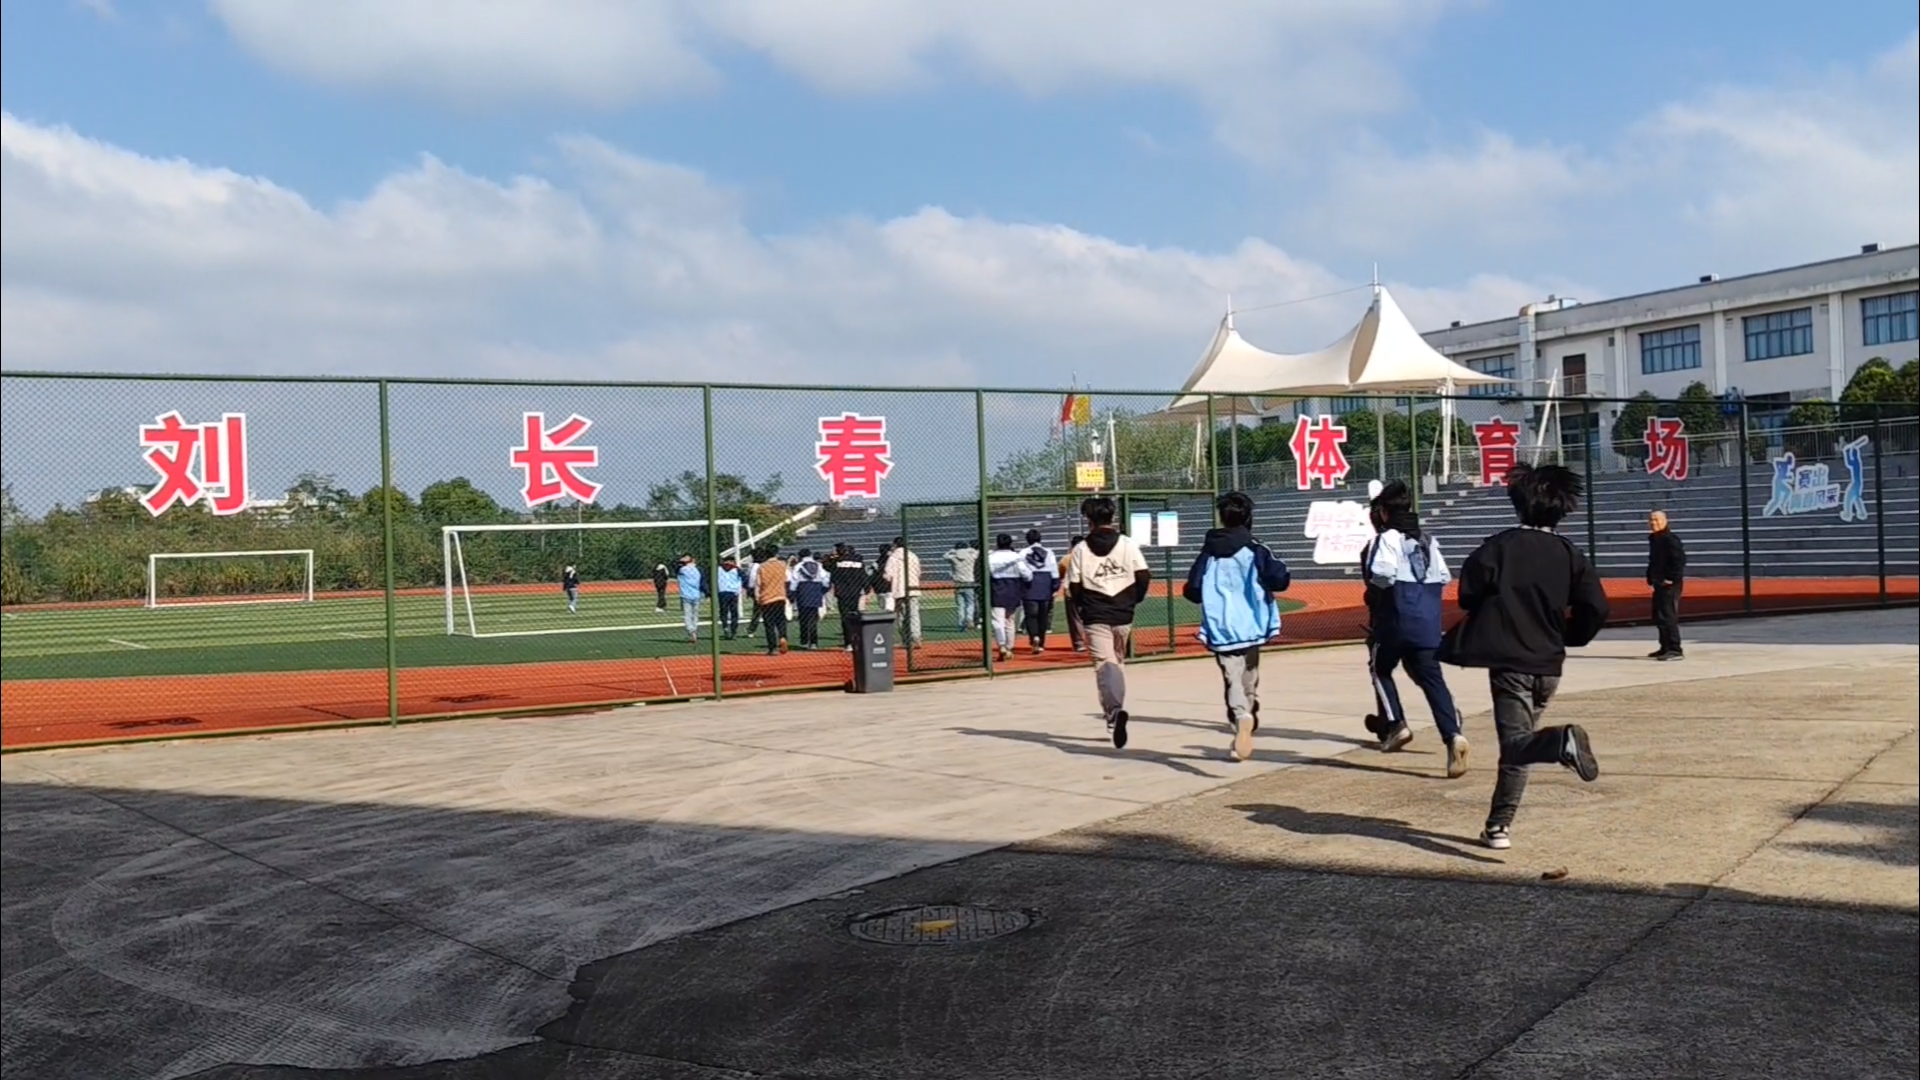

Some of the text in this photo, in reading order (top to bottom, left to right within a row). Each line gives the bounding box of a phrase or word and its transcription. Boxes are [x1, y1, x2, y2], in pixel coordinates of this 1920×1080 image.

[140, 412, 1687, 515] 刘 长 春 体 育 场
